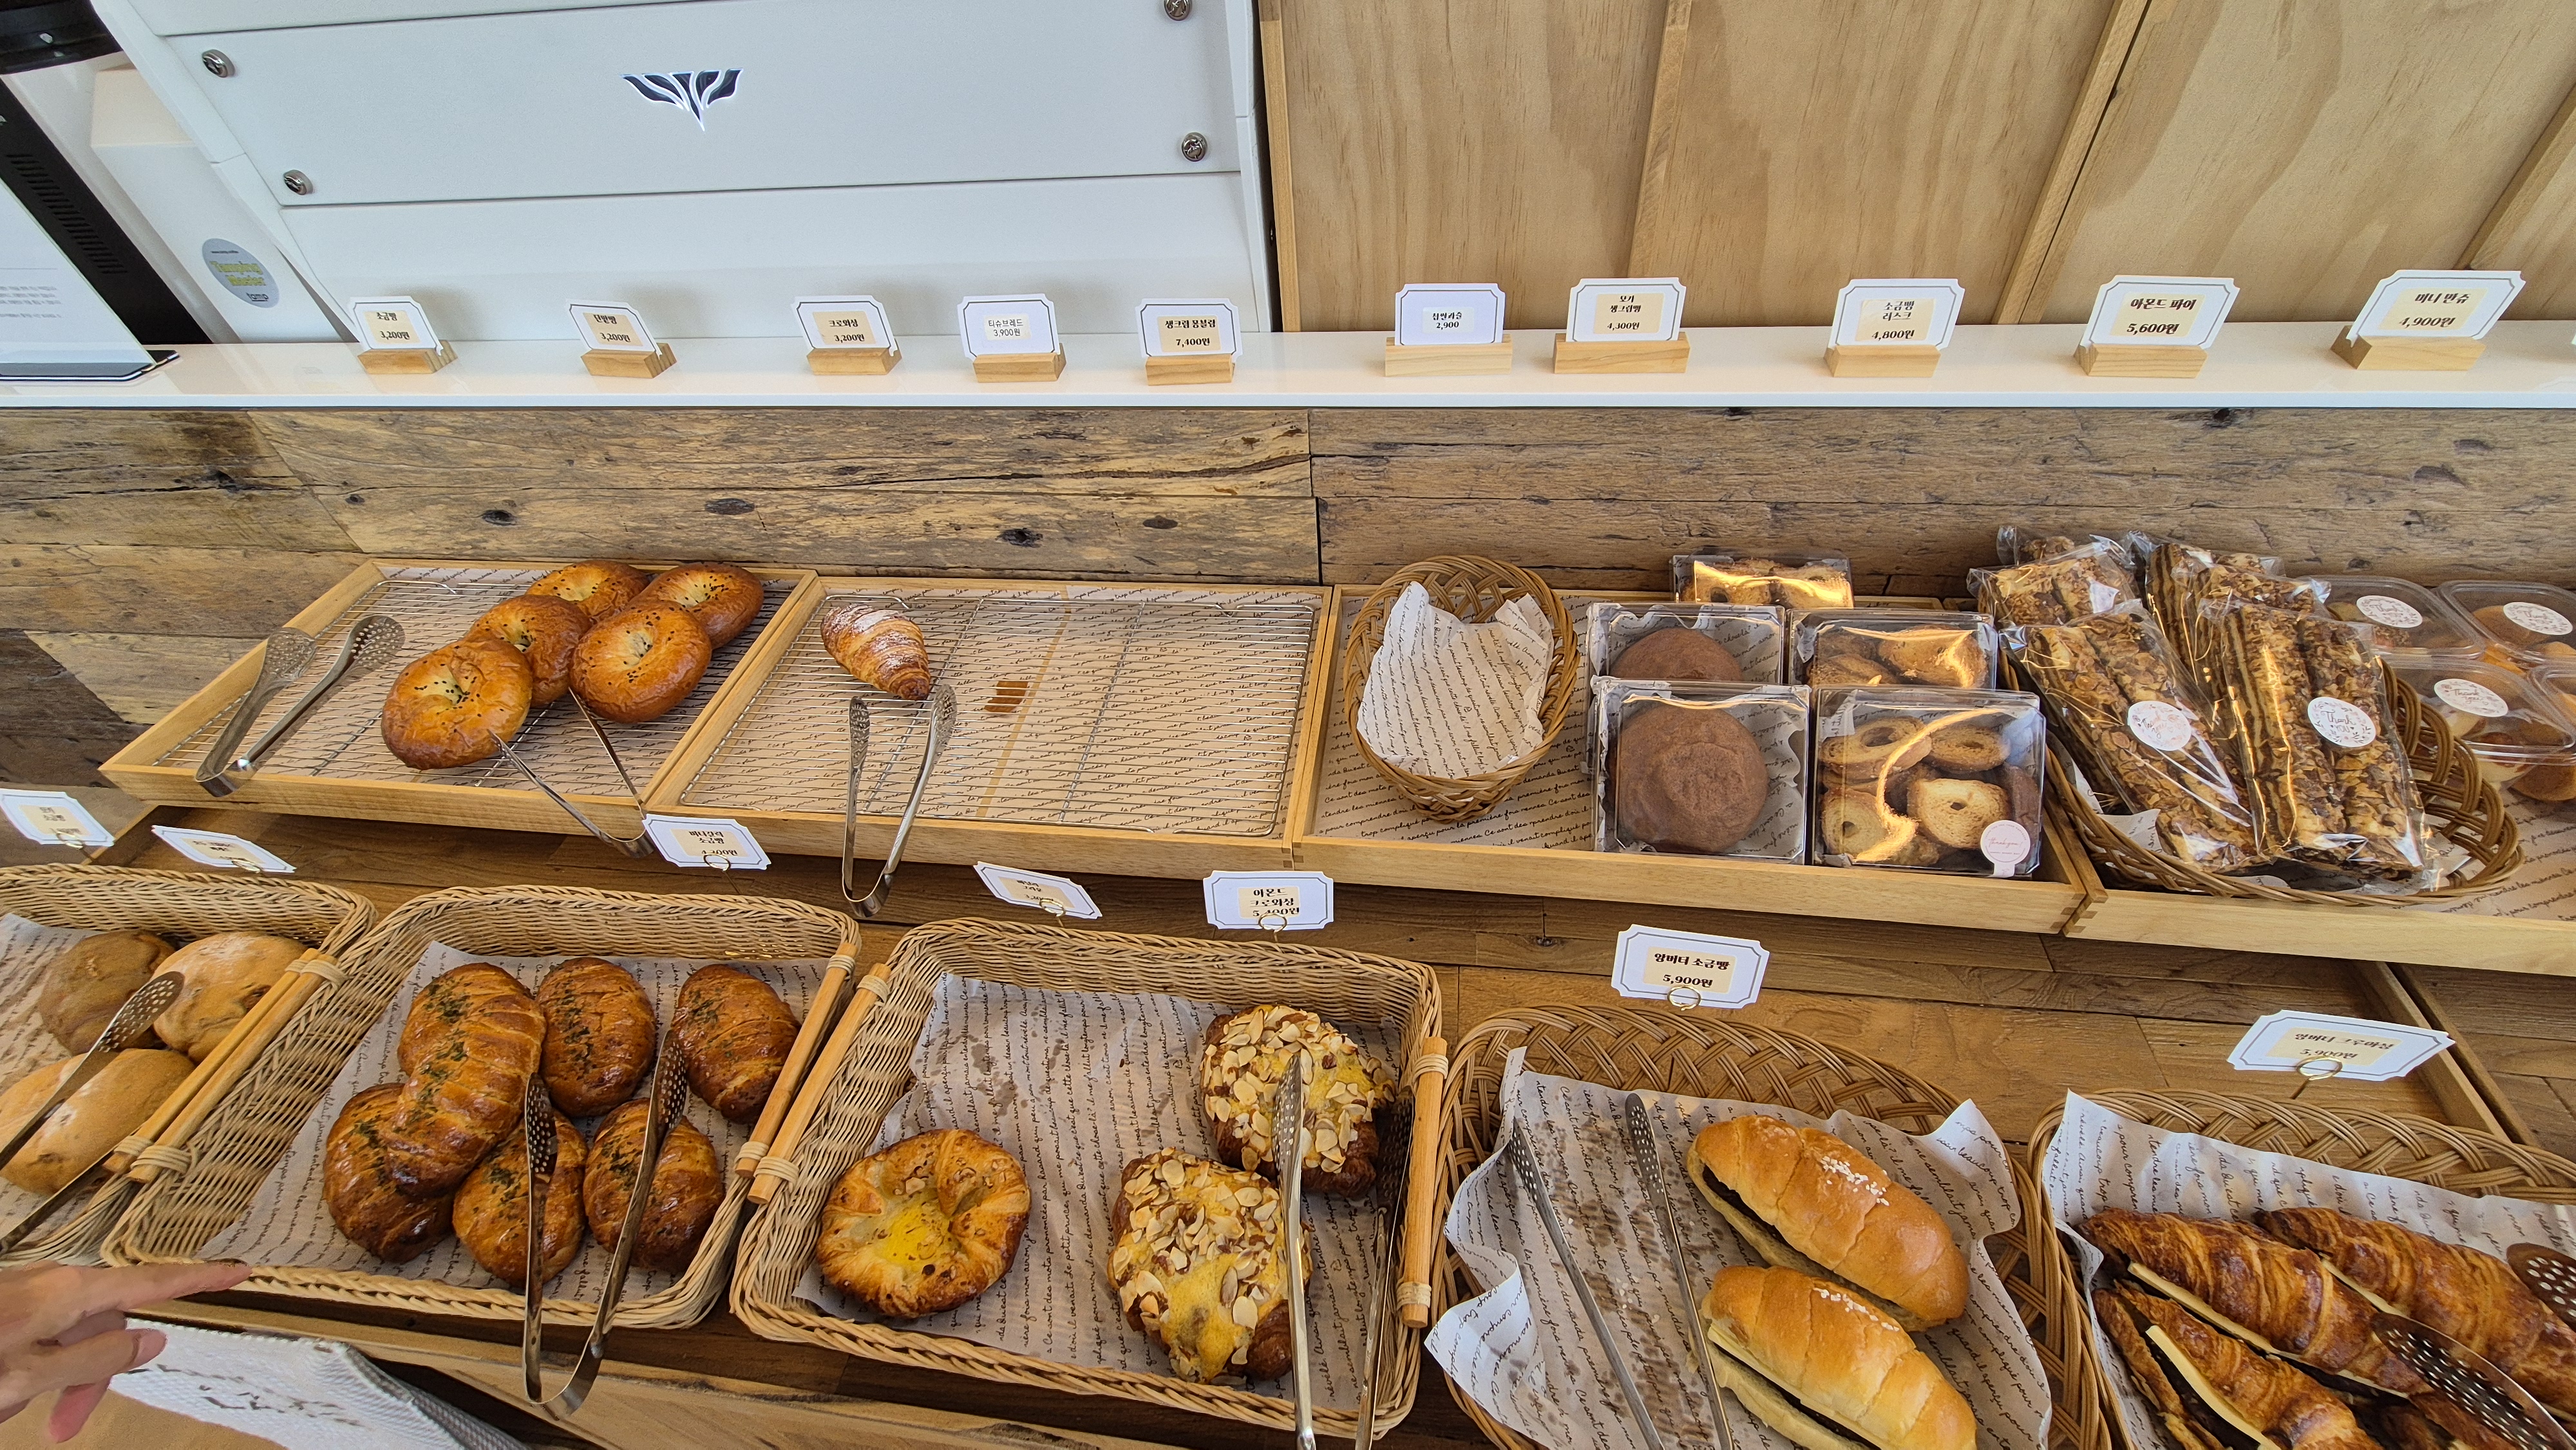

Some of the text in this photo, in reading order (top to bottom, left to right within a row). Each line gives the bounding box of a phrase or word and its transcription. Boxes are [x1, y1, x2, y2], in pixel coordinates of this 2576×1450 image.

[2130, 297, 2197, 310] 아몬드 파이
[2414, 292, 2442, 304] 미니
[1883, 300, 1915, 311] 소금빵
[988, 318, 1024, 328] 티슈브레드
[1436, 321, 1459, 330] 2,900
[2398, 317, 2456, 328] 4,900원
[993, 328, 1021, 338] 3,900원
[2126, 323, 2181, 335] 5,600원
[380, 330, 410, 340] 3,200원
[834, 334, 865, 343] 3,200원
[1871, 329, 1915, 341] 4,800원
[1176, 337, 1210, 348] 7,400원
[2320, 710, 2356, 726] Thank
[1253, 888, 1288, 898] 아몬드
[1654, 952, 1731, 971] 앙버터 소금빵
[1662, 974, 1714, 988] 5,900원
